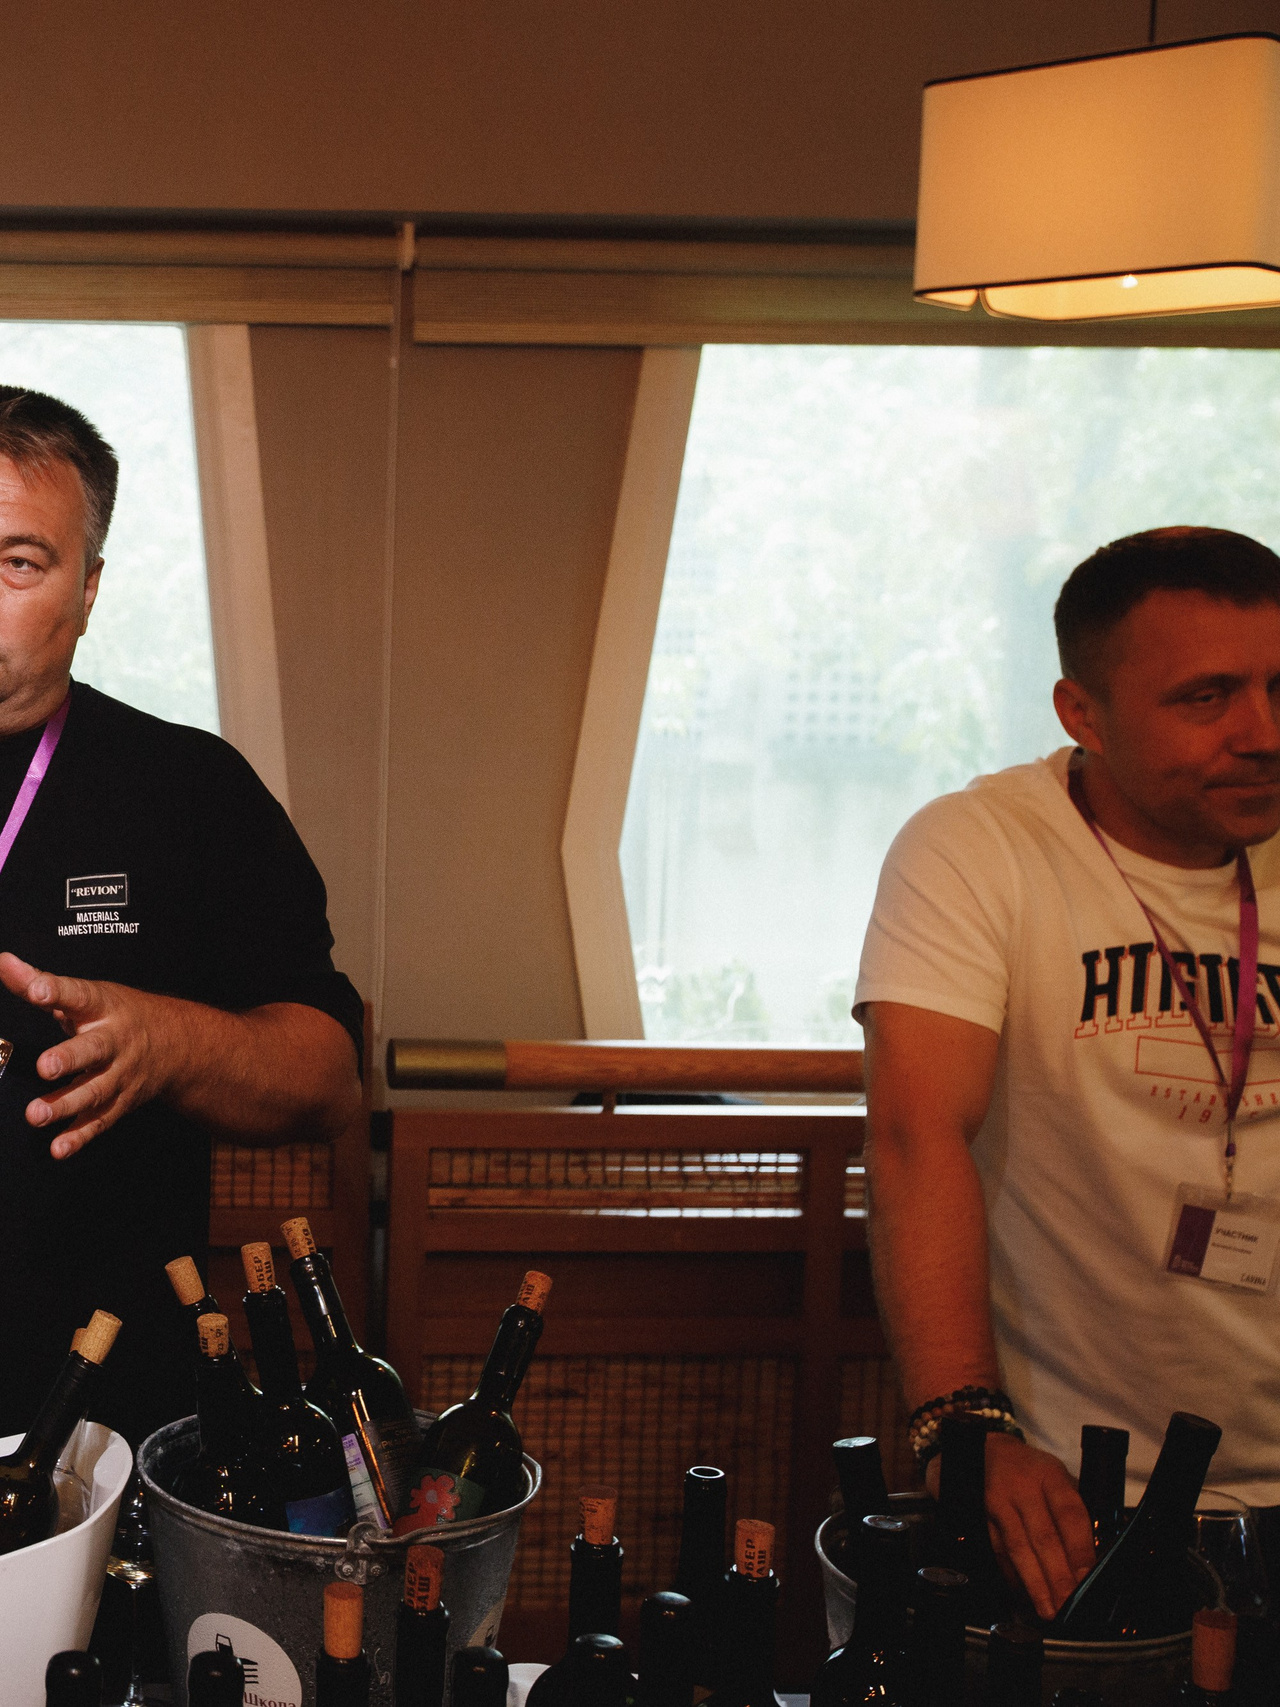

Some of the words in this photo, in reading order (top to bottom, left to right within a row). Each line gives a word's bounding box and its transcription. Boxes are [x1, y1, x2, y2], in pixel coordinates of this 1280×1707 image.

[76, 911, 120, 923] MATERIALS
[104, 922, 140, 934] EXTRACT
[253, 1256, 266, 1291] ОБЕР
[756, 1550, 766, 1575] АШ
